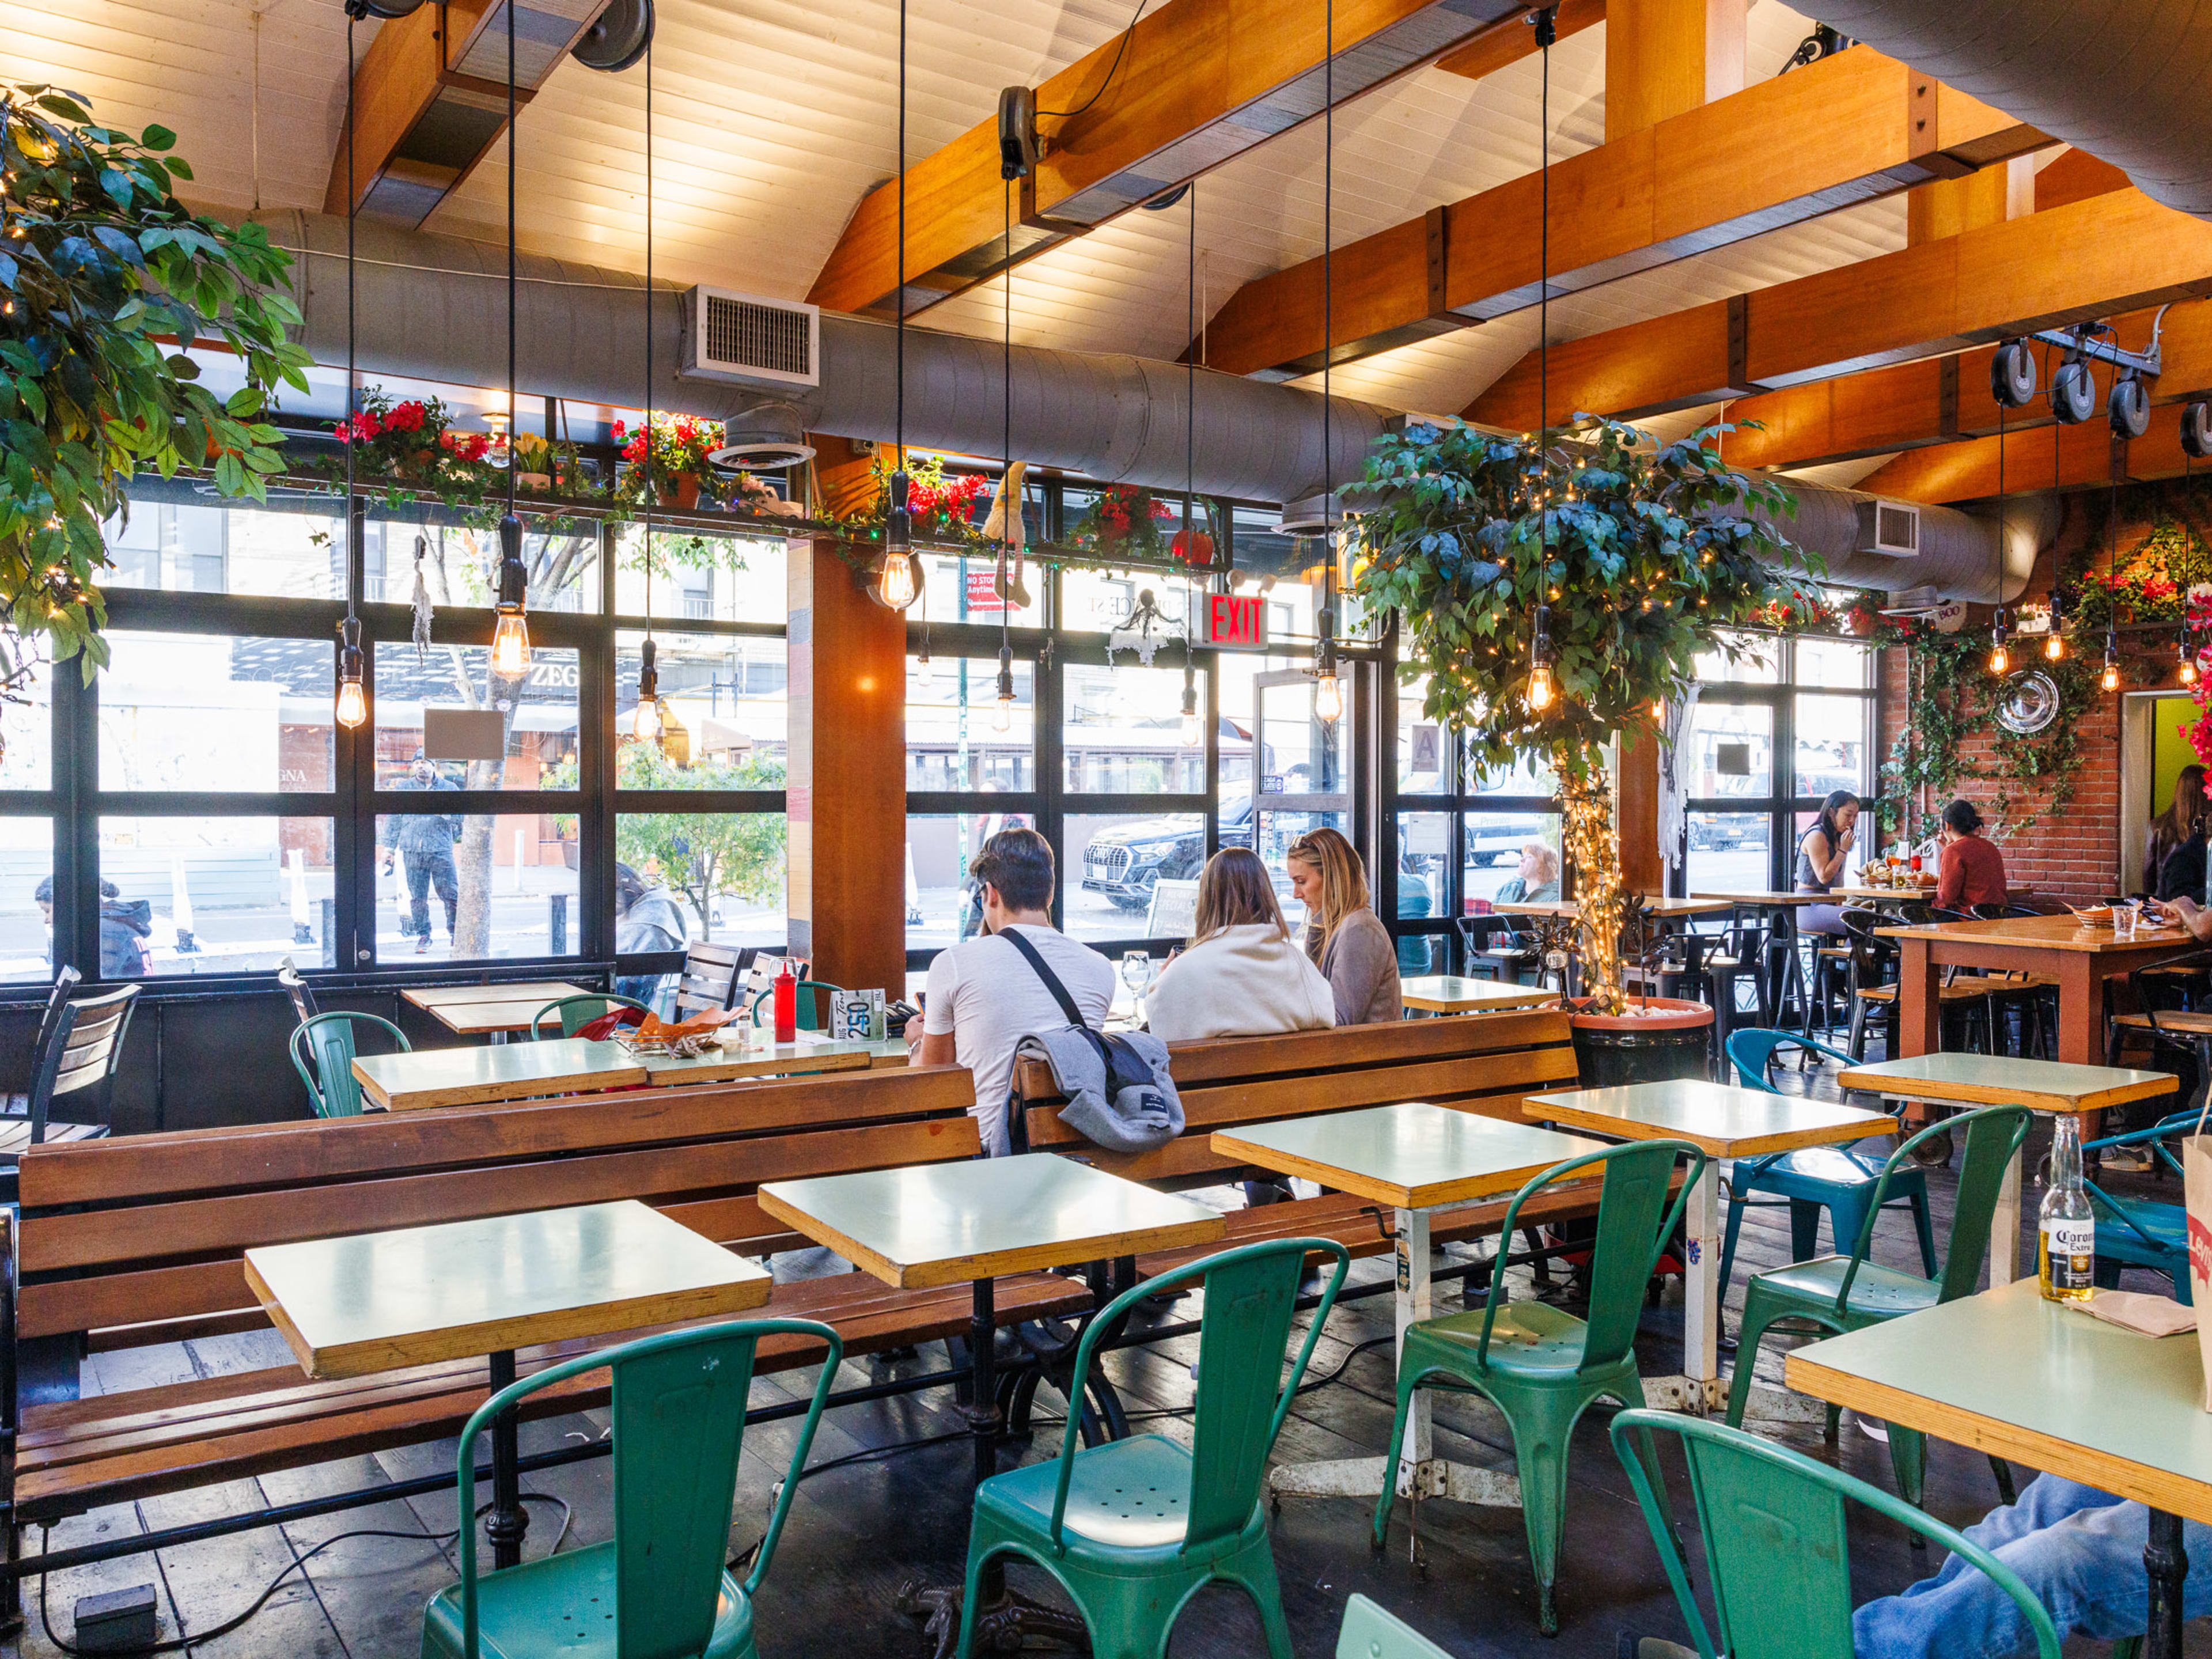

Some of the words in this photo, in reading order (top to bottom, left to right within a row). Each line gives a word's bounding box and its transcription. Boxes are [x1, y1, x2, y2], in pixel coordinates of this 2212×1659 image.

[1211, 595, 1263, 643] EXIT
[1938, 605, 1960, 620] BOO
[1416, 730, 1435, 759] A
[847, 1002, 870, 1039] 250
[838, 1028, 847, 1040] AUG
[2070, 1243, 2090, 1251] Extra
